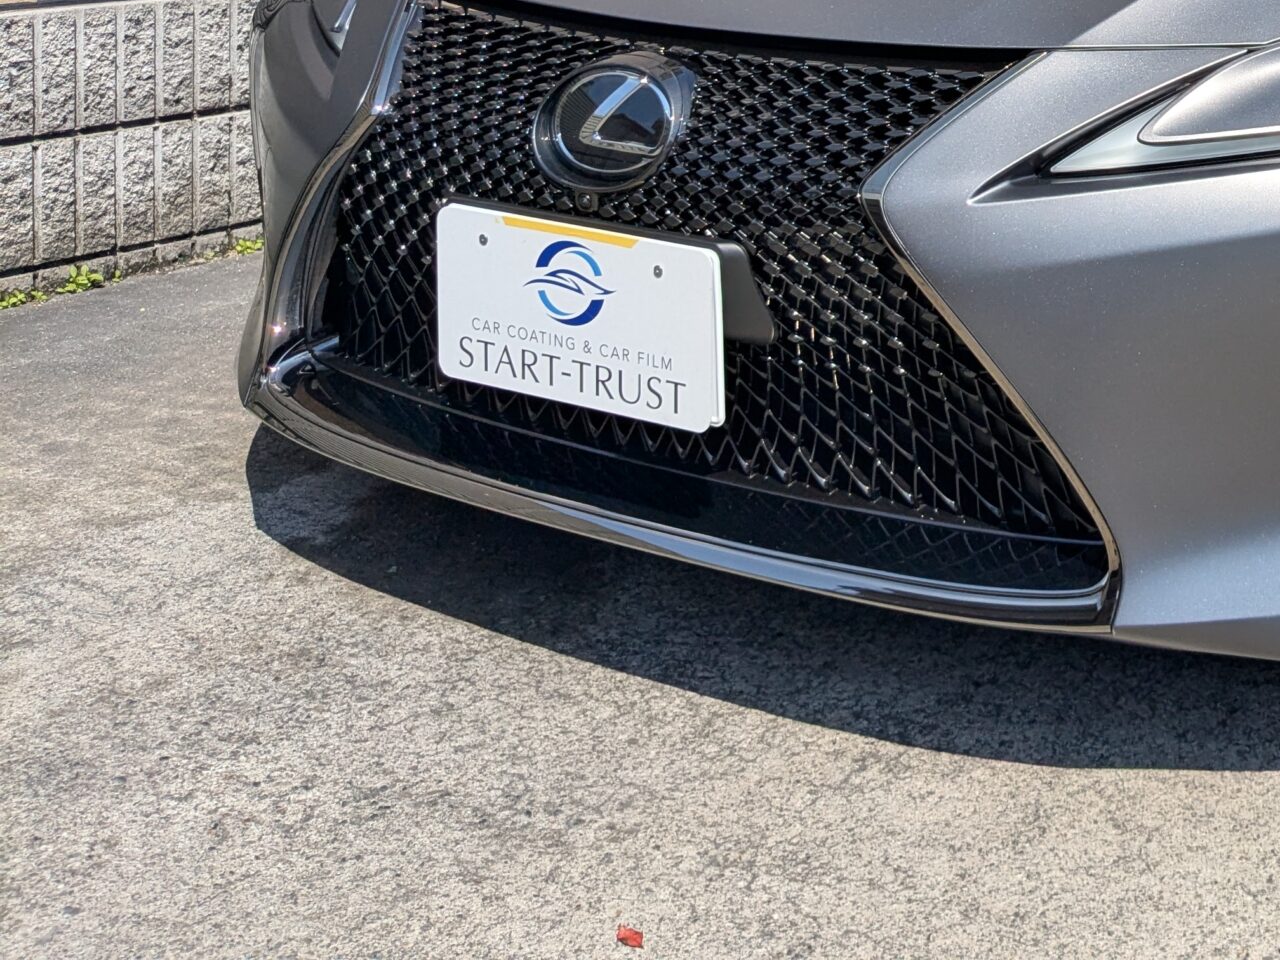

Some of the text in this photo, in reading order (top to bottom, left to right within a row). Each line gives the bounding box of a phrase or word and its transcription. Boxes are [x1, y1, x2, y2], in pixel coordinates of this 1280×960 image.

[459, 336, 686, 414] START-TRUST
[471, 317, 672, 371] CAR COATING & CAR FILM
